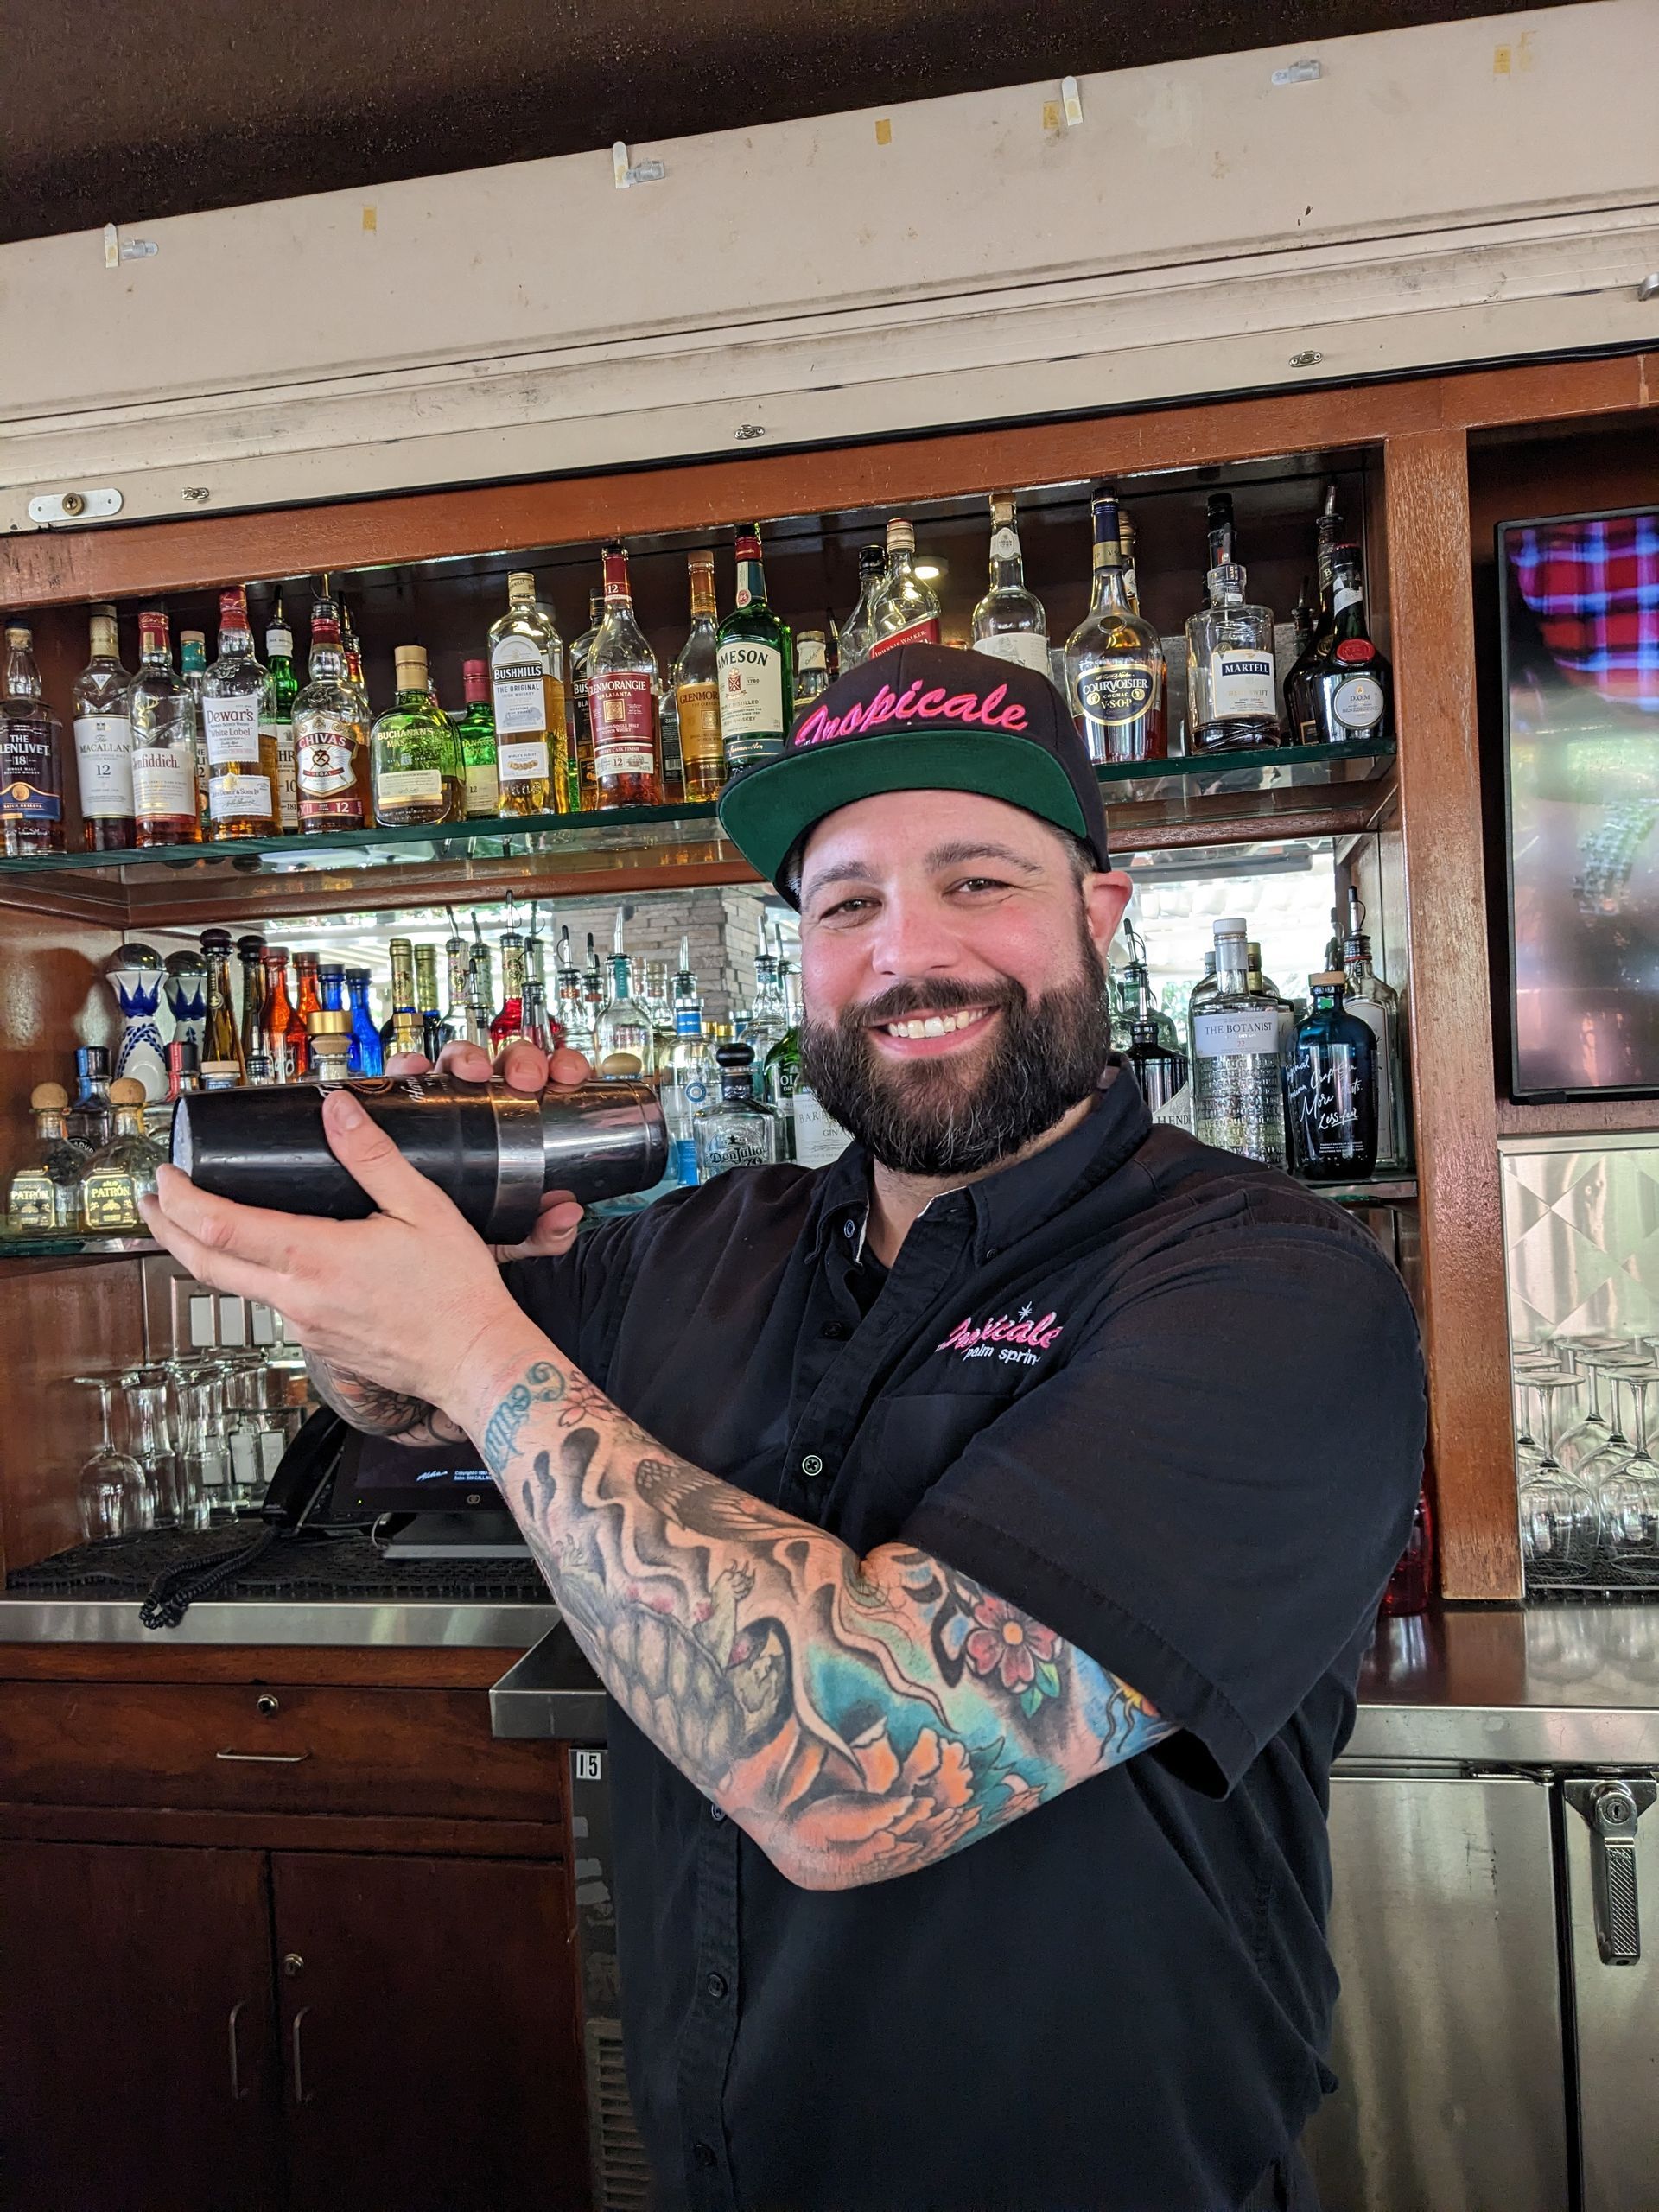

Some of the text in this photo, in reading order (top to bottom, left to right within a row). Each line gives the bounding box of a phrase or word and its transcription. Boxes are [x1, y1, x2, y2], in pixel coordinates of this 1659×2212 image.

[607, 584, 619, 594] 12
[900, 630, 927, 645] WALKER
[717, 649, 768, 671] AMESON
[494, 666, 542, 680] BUSHMILLS
[1224, 663, 1269, 674] MARTELL
[509, 683, 540, 692] ORIGINAL
[588, 680, 647, 696] GLENMORANGIE
[1083, 678, 1148, 694] COURVOISIER
[679, 690, 719, 706] GLENMOR
[207, 709, 255, 724] Dewar's
[229, 728, 251, 736] Label
[377, 728, 434, 741] BUCHANAN'S
[10, 734, 29, 744] THE
[298, 734, 346, 749] CHIVAS
[0, 743, 50, 757] LENLIVET
[79, 743, 130, 753] MACALLAN
[13, 755, 27, 766] 18
[613, 757, 624, 766] 12
[95, 764, 111, 777] 12
[335, 802, 350, 813] 12
[1205, 1022, 1273, 1035] THE BOTANIST
[1157, 1114, 1190, 1125] HEND
[1318, 1113, 1339, 1130] Less
[823, 1128, 838, 1137] GIN
[91, 1184, 131, 1198] PATRÓN
[962, 1343, 1041, 1366] palm sprin
[579, 1753, 598, 1777] 15
